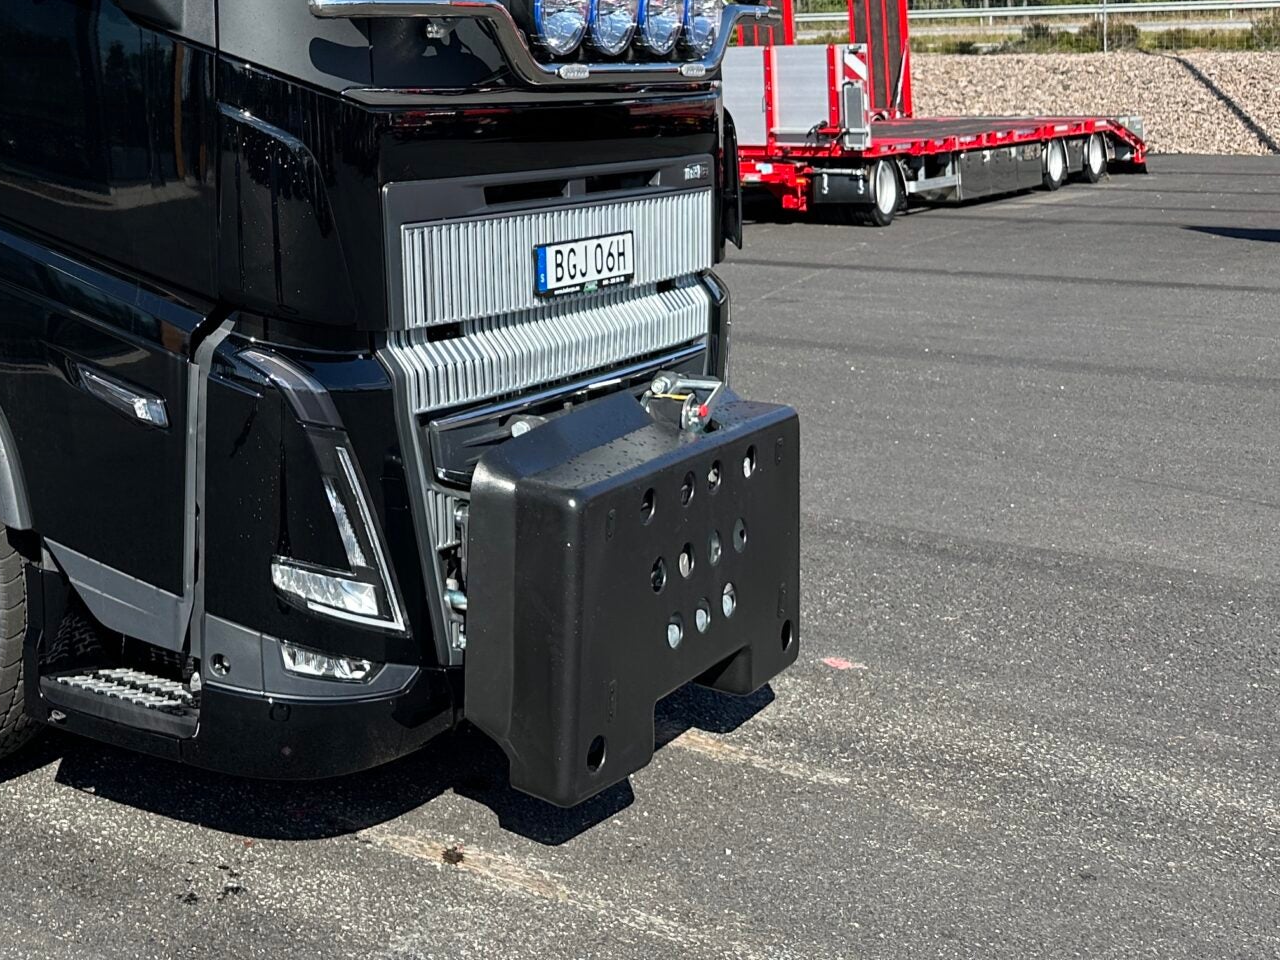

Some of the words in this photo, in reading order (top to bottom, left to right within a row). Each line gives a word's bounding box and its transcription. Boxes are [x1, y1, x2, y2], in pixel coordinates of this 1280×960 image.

[554, 244, 588, 283] BGJ
[594, 238, 626, 274] 06H
[539, 273, 545, 283] S
